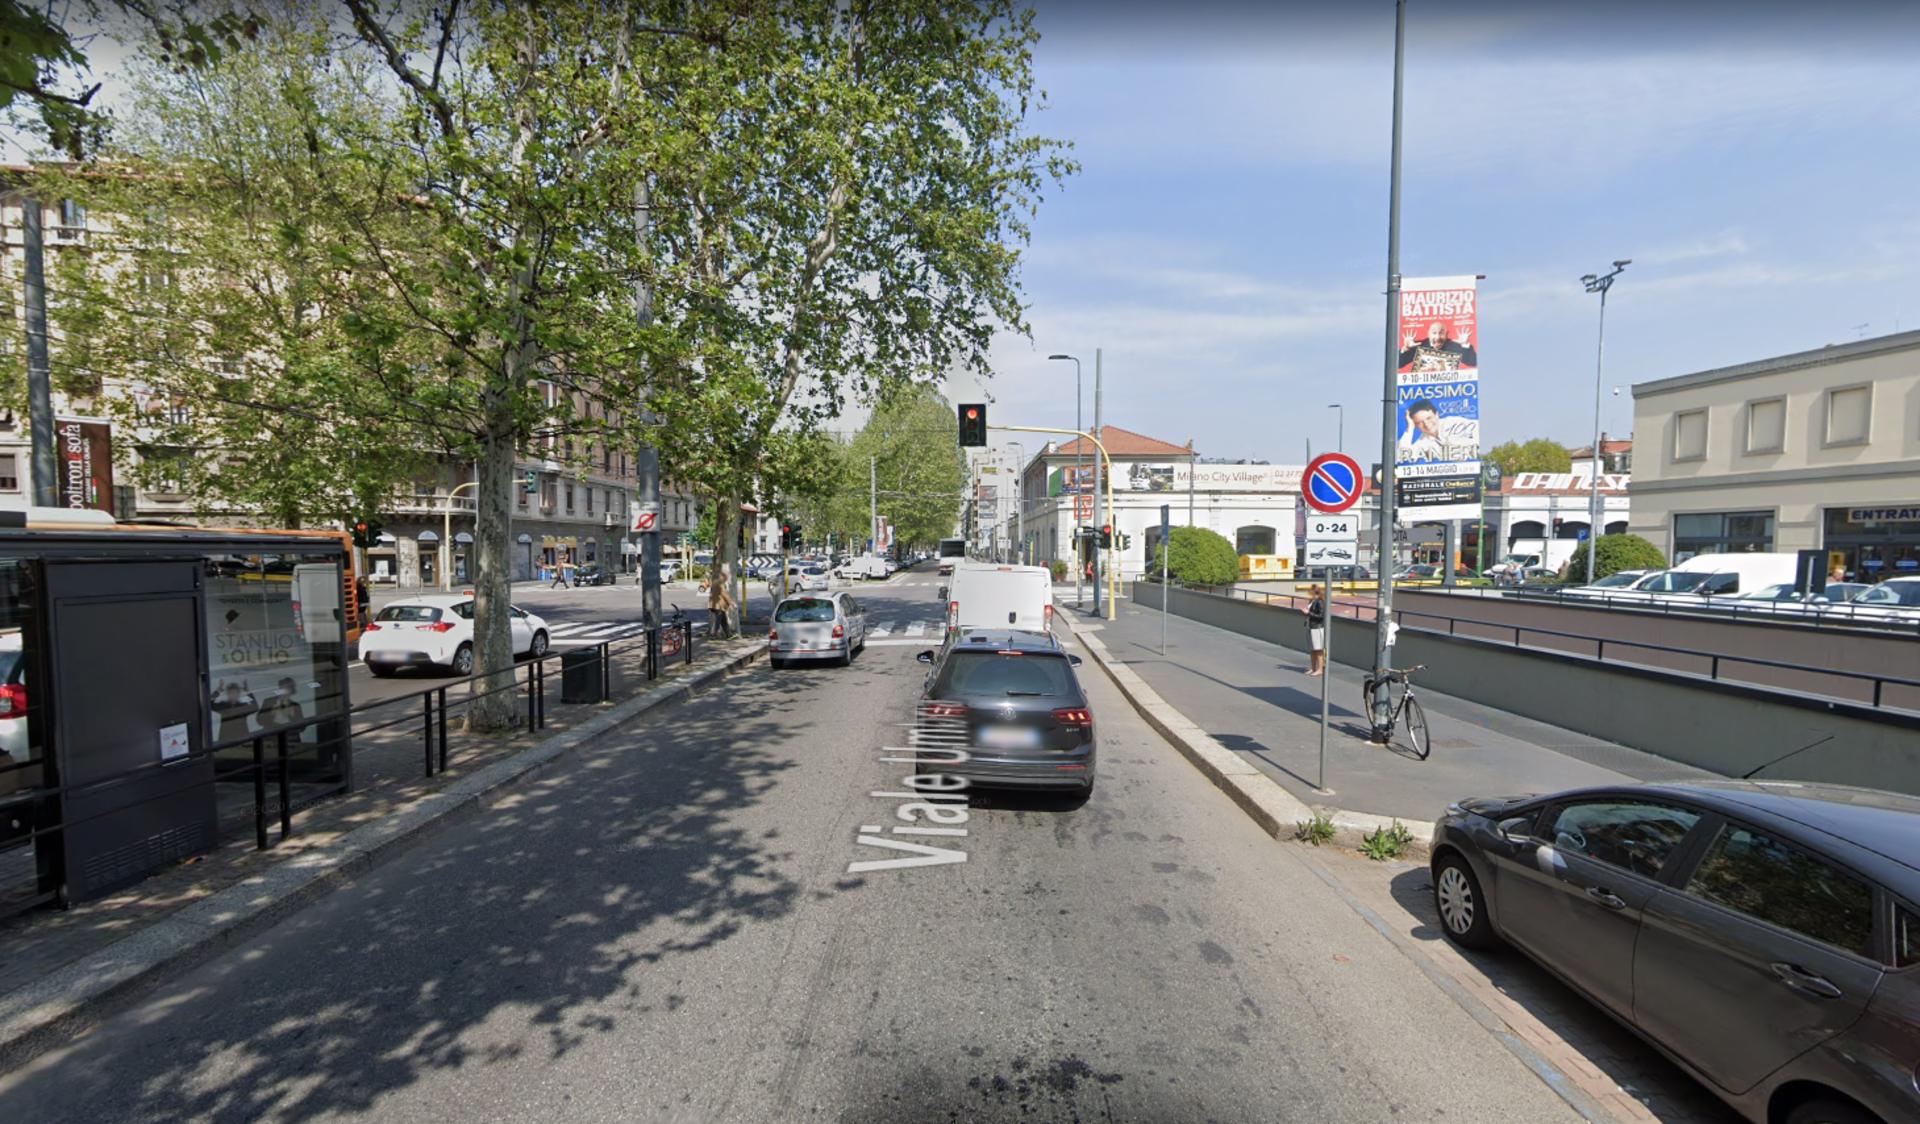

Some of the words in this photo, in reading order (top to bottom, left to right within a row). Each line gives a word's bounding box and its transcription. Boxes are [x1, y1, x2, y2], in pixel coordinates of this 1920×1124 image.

[1402, 290, 1474, 305] MAURIZIO
[1402, 303, 1474, 317] BATTISTA
[1430, 371, 1459, 382] MAGGIO
[1399, 383, 1476, 400] MASSIMO
[1396, 444, 1479, 464] RANIERI
[1426, 463, 1458, 475] MAGGIO
[1177, 471, 1209, 481] Miano
[1211, 471, 1231, 484] City
[1232, 471, 1265, 485] Village
[215, 633, 294, 650] STANLIO
